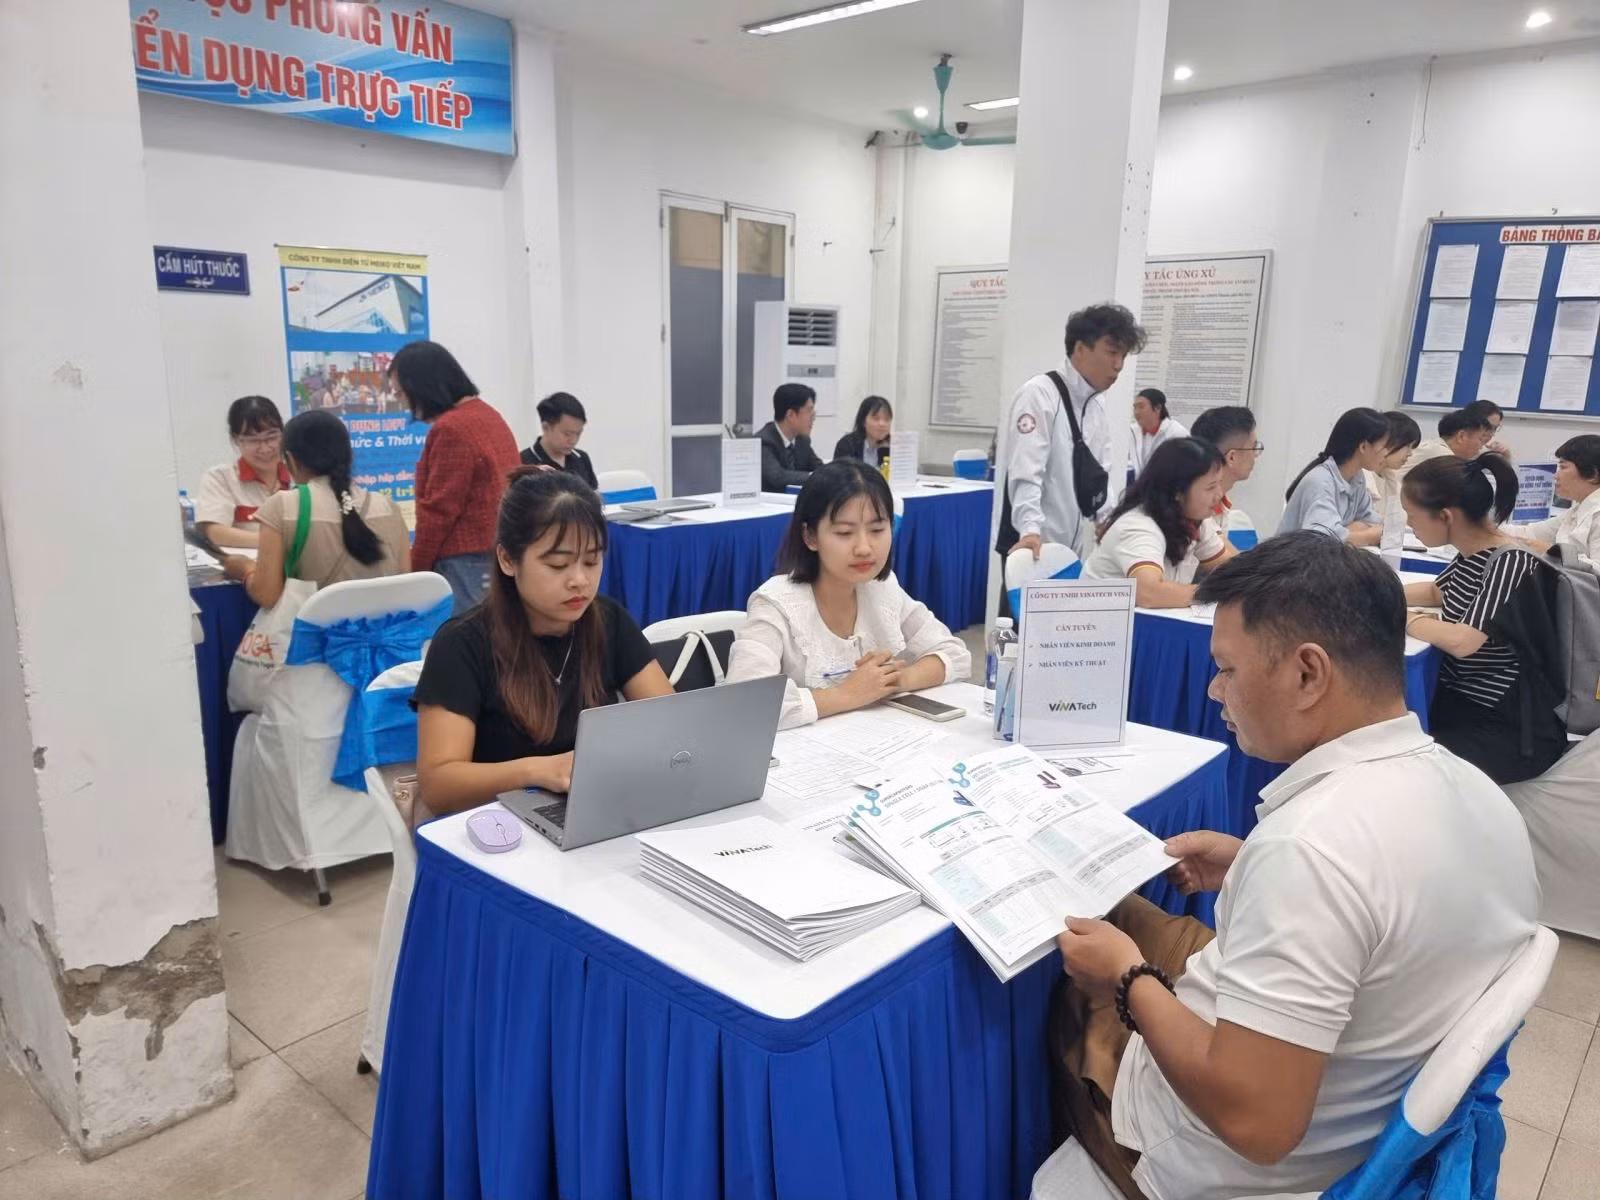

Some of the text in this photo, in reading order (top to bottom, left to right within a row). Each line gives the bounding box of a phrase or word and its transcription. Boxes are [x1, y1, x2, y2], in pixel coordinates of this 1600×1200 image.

[391, 7, 453, 63] VẤN
[203, 38, 306, 98] DỤNG
[315, 63, 400, 121] TRỰC
[409, 81, 471, 129] TIẾP
[1502, 226, 1537, 242] BẢNG
[1542, 225, 1584, 241] THÔNG
[157, 252, 240, 278] CẤM HÚT THUỐC
[311, 255, 320, 263] TY
[375, 436, 385, 448] &
[387, 433, 413, 447] Thời
[1030, 591, 1050, 599] CÔNG
[1039, 641, 1059, 649] NHÂN
[1038, 660, 1057, 668] NHÂN
[1058, 660, 1074, 668] VIÊN
